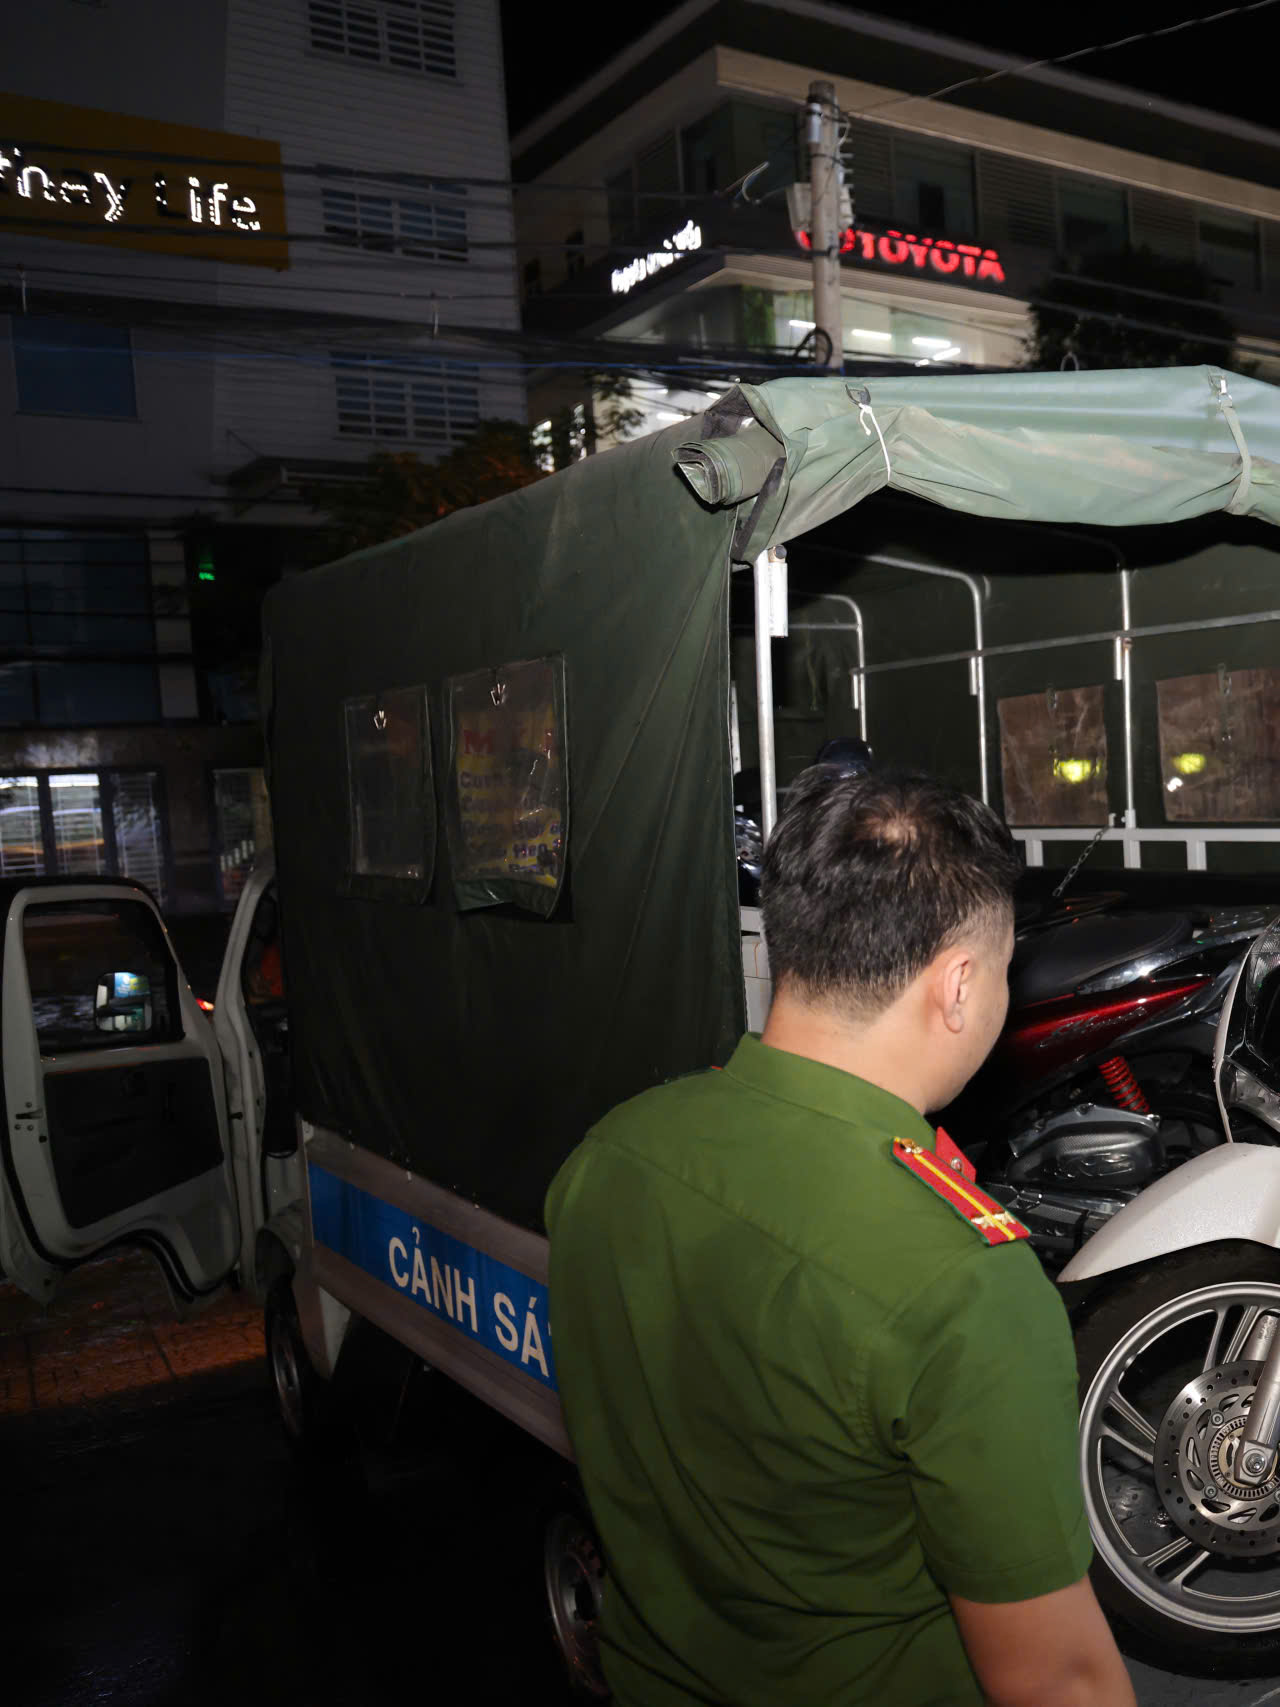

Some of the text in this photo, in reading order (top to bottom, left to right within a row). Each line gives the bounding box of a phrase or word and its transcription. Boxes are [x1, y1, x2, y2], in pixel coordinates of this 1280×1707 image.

[856, 230, 1006, 283] TOYOTA
[388, 1226, 552, 1378] CẢNH SÁ
